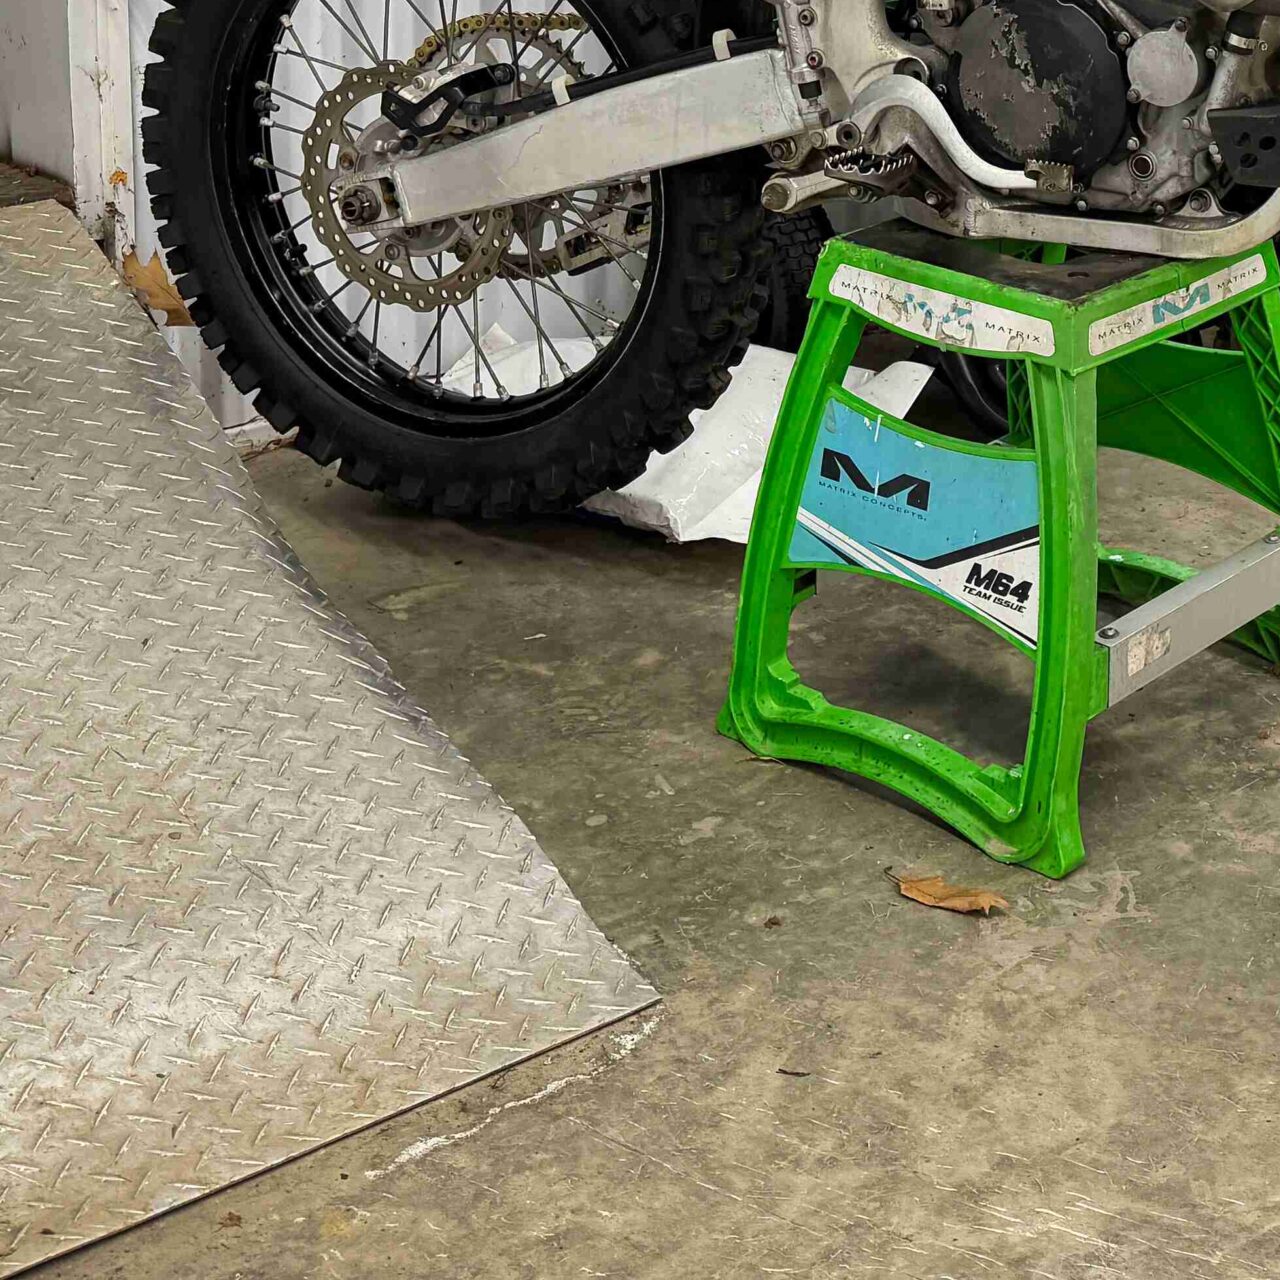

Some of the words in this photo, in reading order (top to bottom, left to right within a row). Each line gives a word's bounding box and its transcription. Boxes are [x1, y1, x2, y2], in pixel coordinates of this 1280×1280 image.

[841, 281, 893, 300] MATRIX
[985, 321, 1041, 343] MATRIX
[1098, 317, 1144, 340] MATRIX
[1215, 267, 1258, 290] MATRIX
[818, 481, 856, 498] MATRIX
[963, 585, 992, 601] TEAM
[993, 596, 1027, 614] ISSUE
[965, 562, 1033, 604] M64
